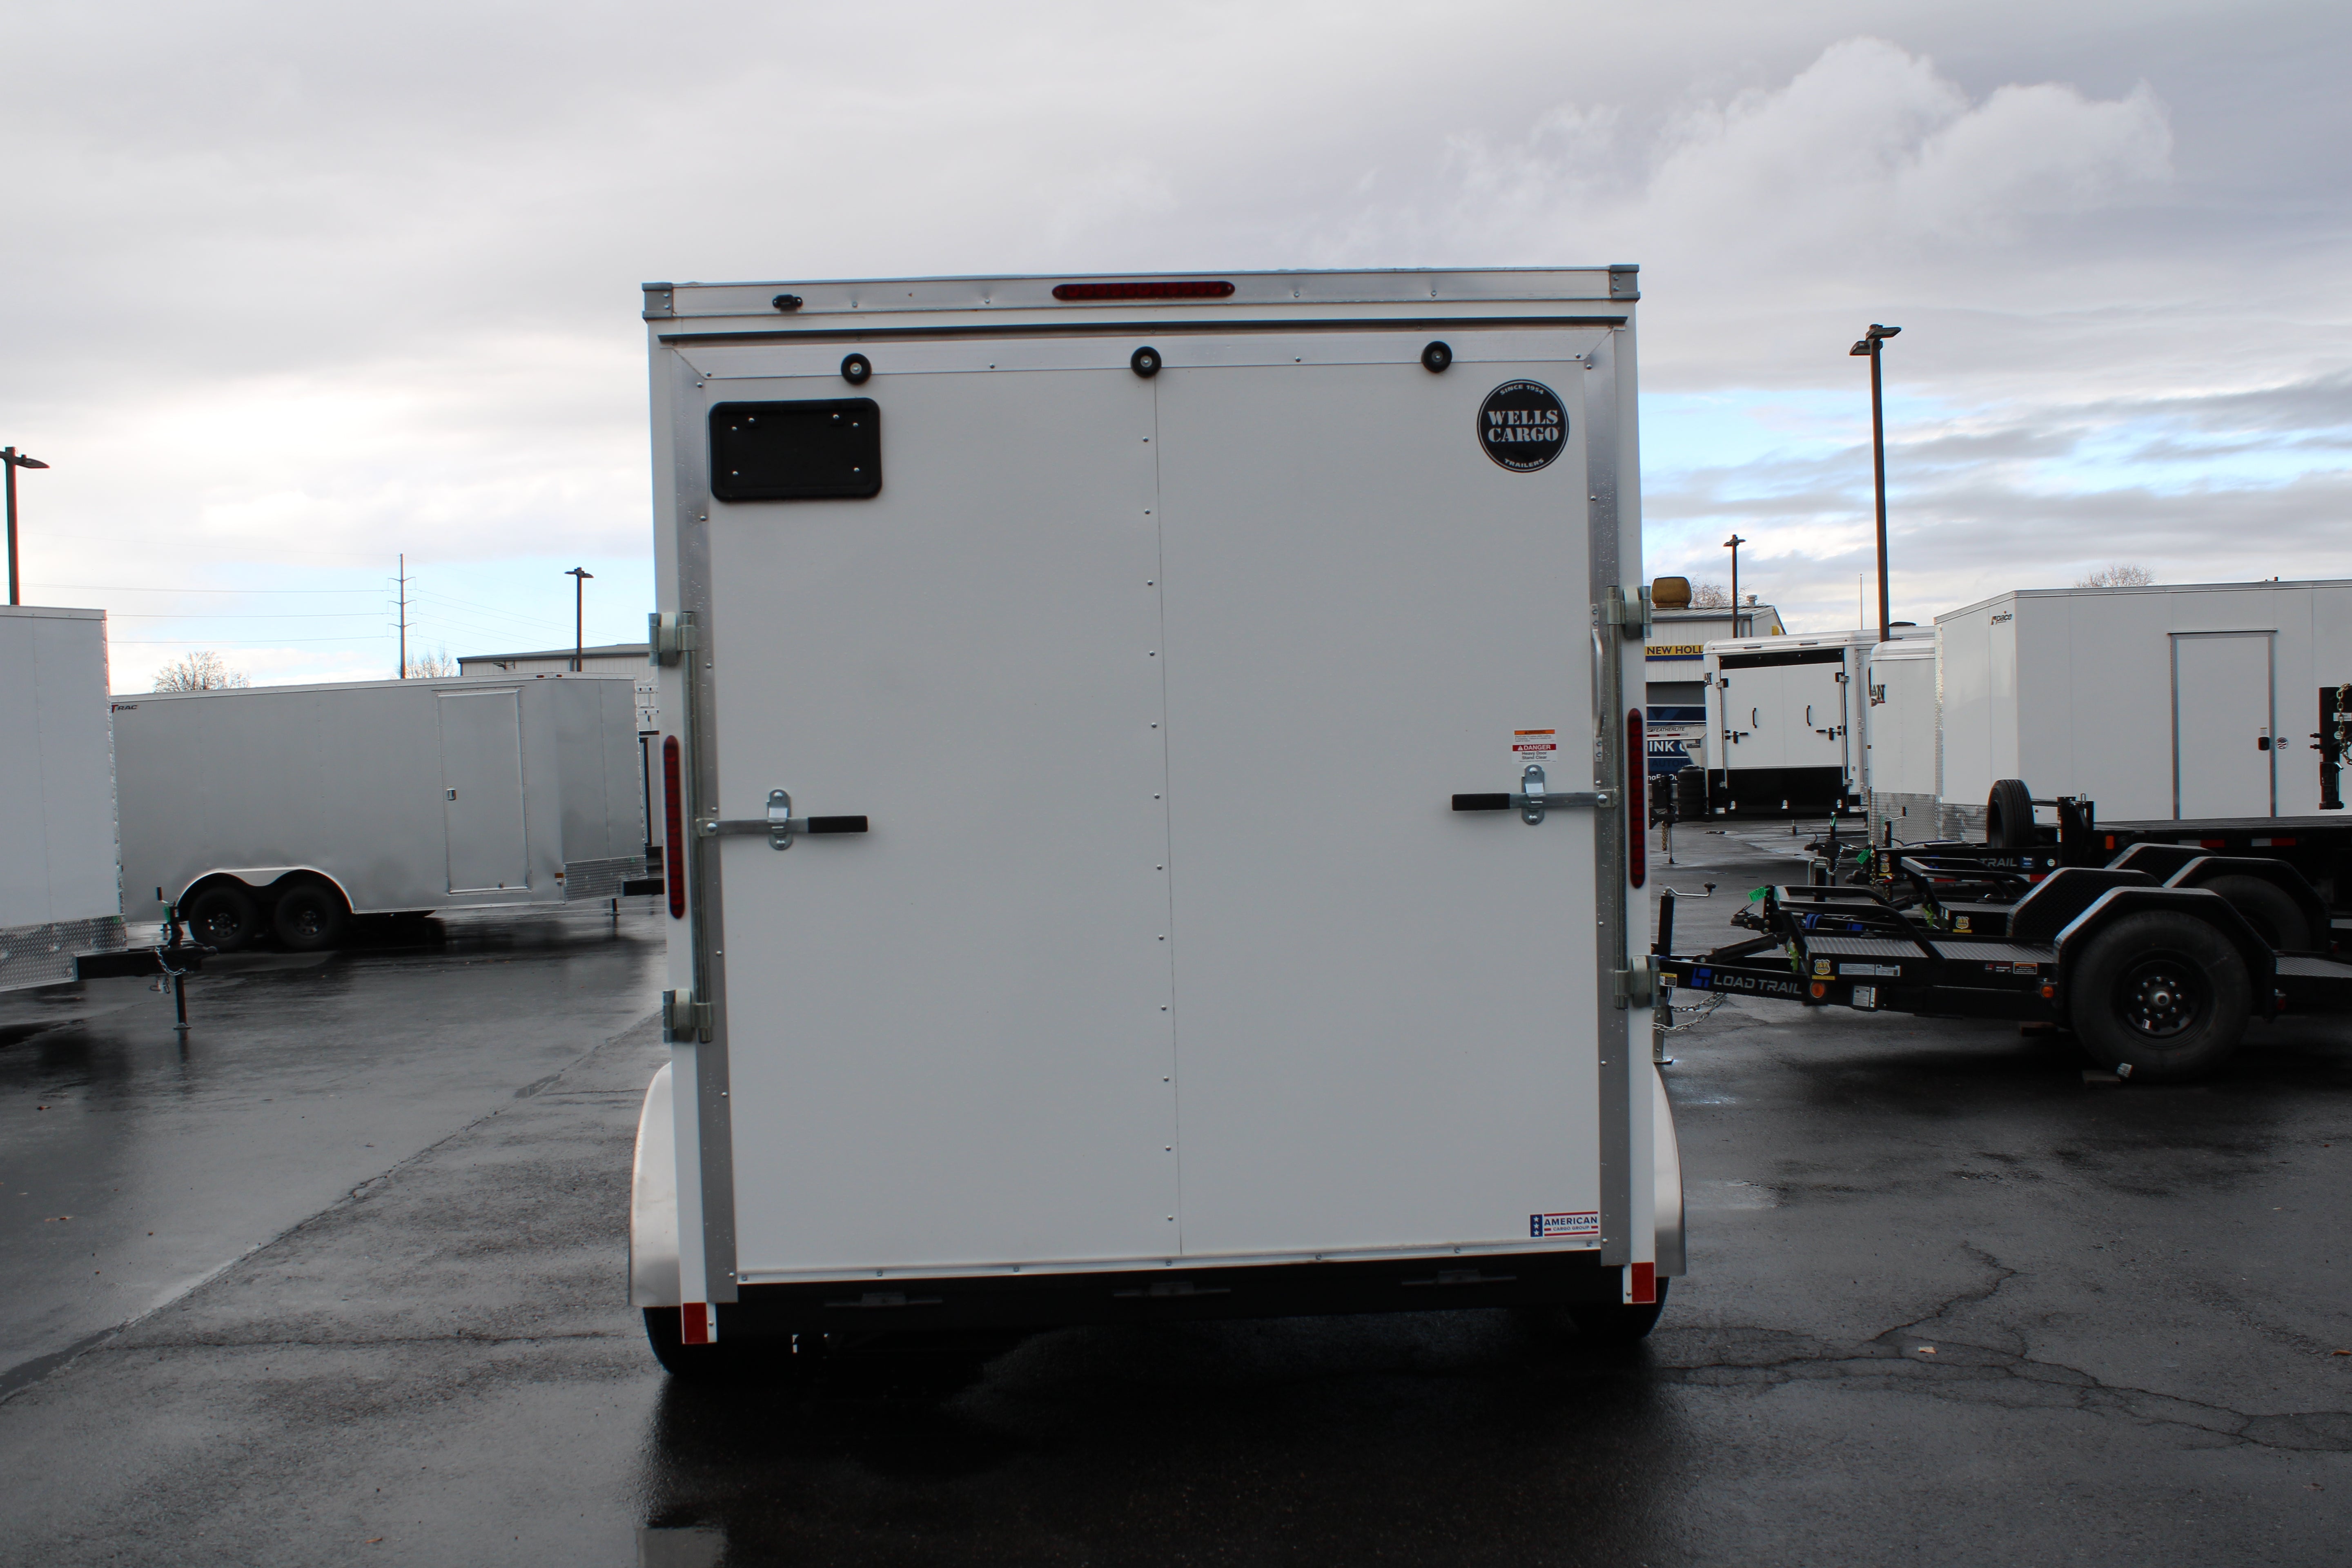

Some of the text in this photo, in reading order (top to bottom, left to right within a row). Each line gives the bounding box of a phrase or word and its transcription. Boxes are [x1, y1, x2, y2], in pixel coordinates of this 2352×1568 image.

[1500, 385, 1544, 395] SINCE 1954
[1488, 410, 1558, 425] WELLS
[1488, 427, 1559, 442] CARGO
[1504, 458, 1544, 468] TRAILERS
[1647, 646, 1703, 655] NEW HOLL
[1649, 741, 1675, 752] INK
[1980, 858, 2017, 867] TRAIL
[1713, 974, 1803, 994] LOAD TRAIL
[1544, 1216, 1597, 1226] AMERICAN
